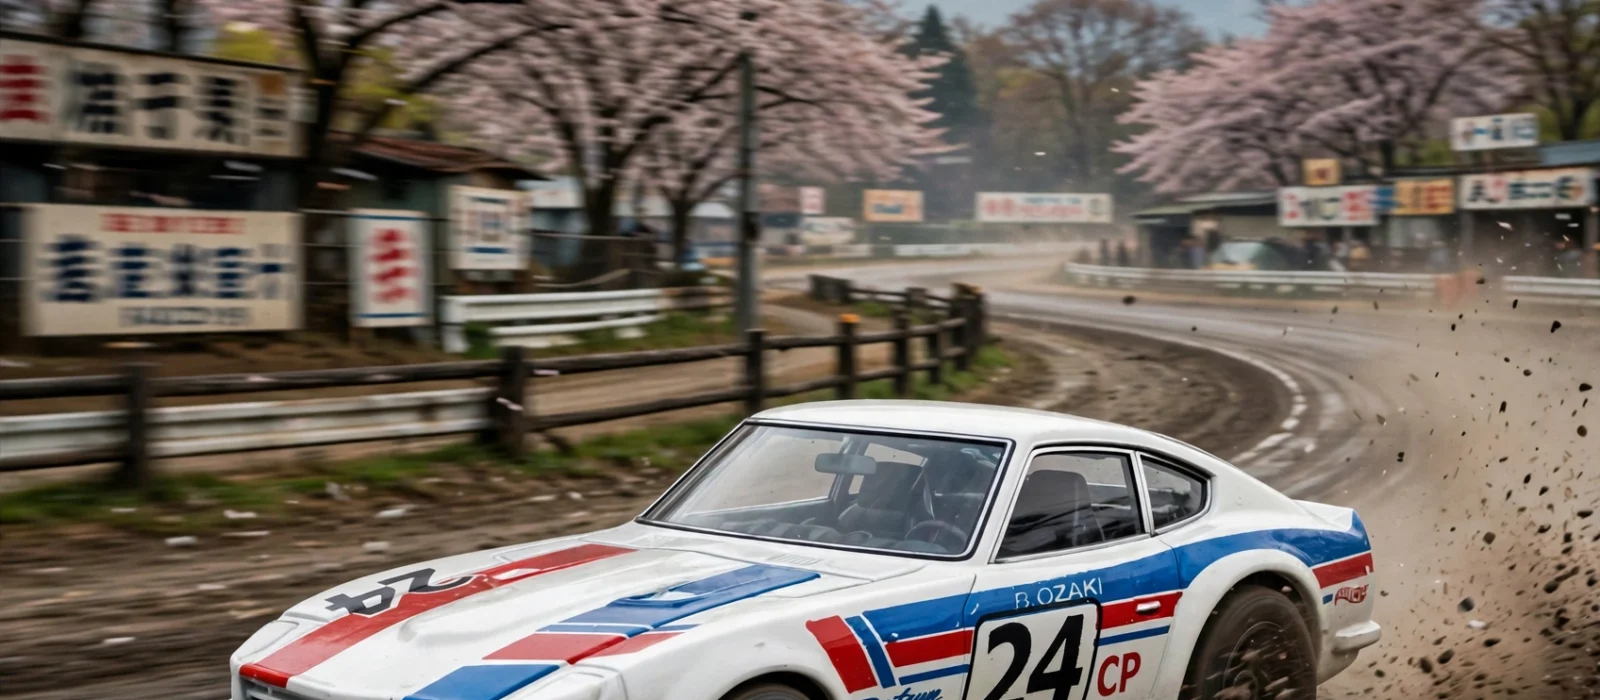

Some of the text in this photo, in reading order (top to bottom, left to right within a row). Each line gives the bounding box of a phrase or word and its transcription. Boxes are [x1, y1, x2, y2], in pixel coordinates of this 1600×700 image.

[324, 568, 474, 616] 24
[983, 613, 1084, 700] 24
[1097, 651, 1142, 697] CP
